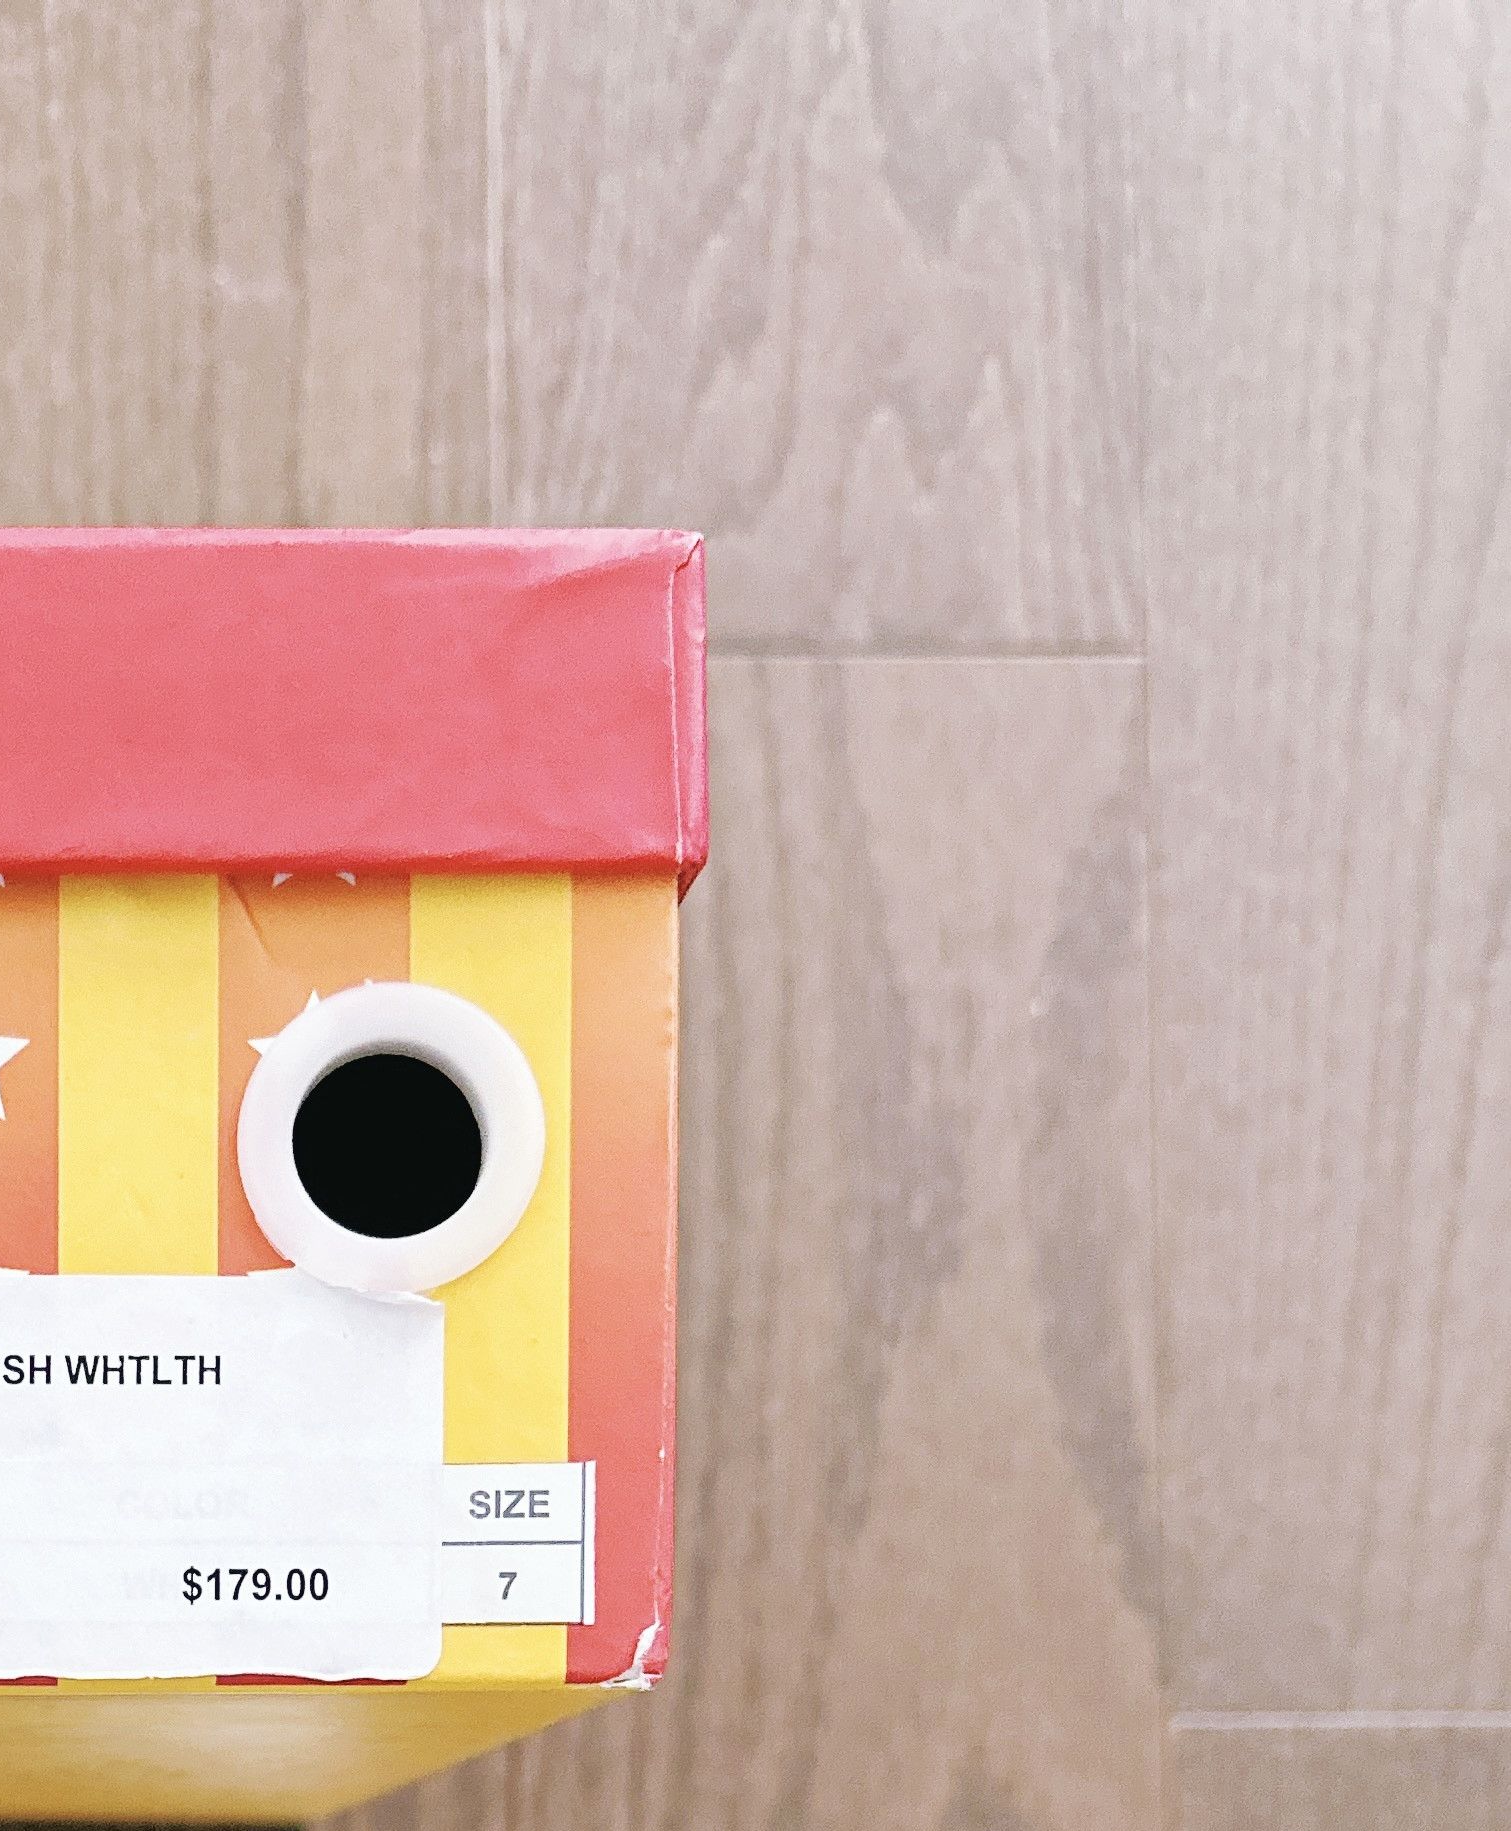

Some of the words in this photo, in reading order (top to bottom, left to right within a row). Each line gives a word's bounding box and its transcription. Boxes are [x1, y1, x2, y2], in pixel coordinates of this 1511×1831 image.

[64, 1353, 222, 1386] WHTLTH
[468, 1488, 551, 1520] SIZE
[181, 1565, 329, 1605] $179.00
[497, 1571, 518, 1601] 7
